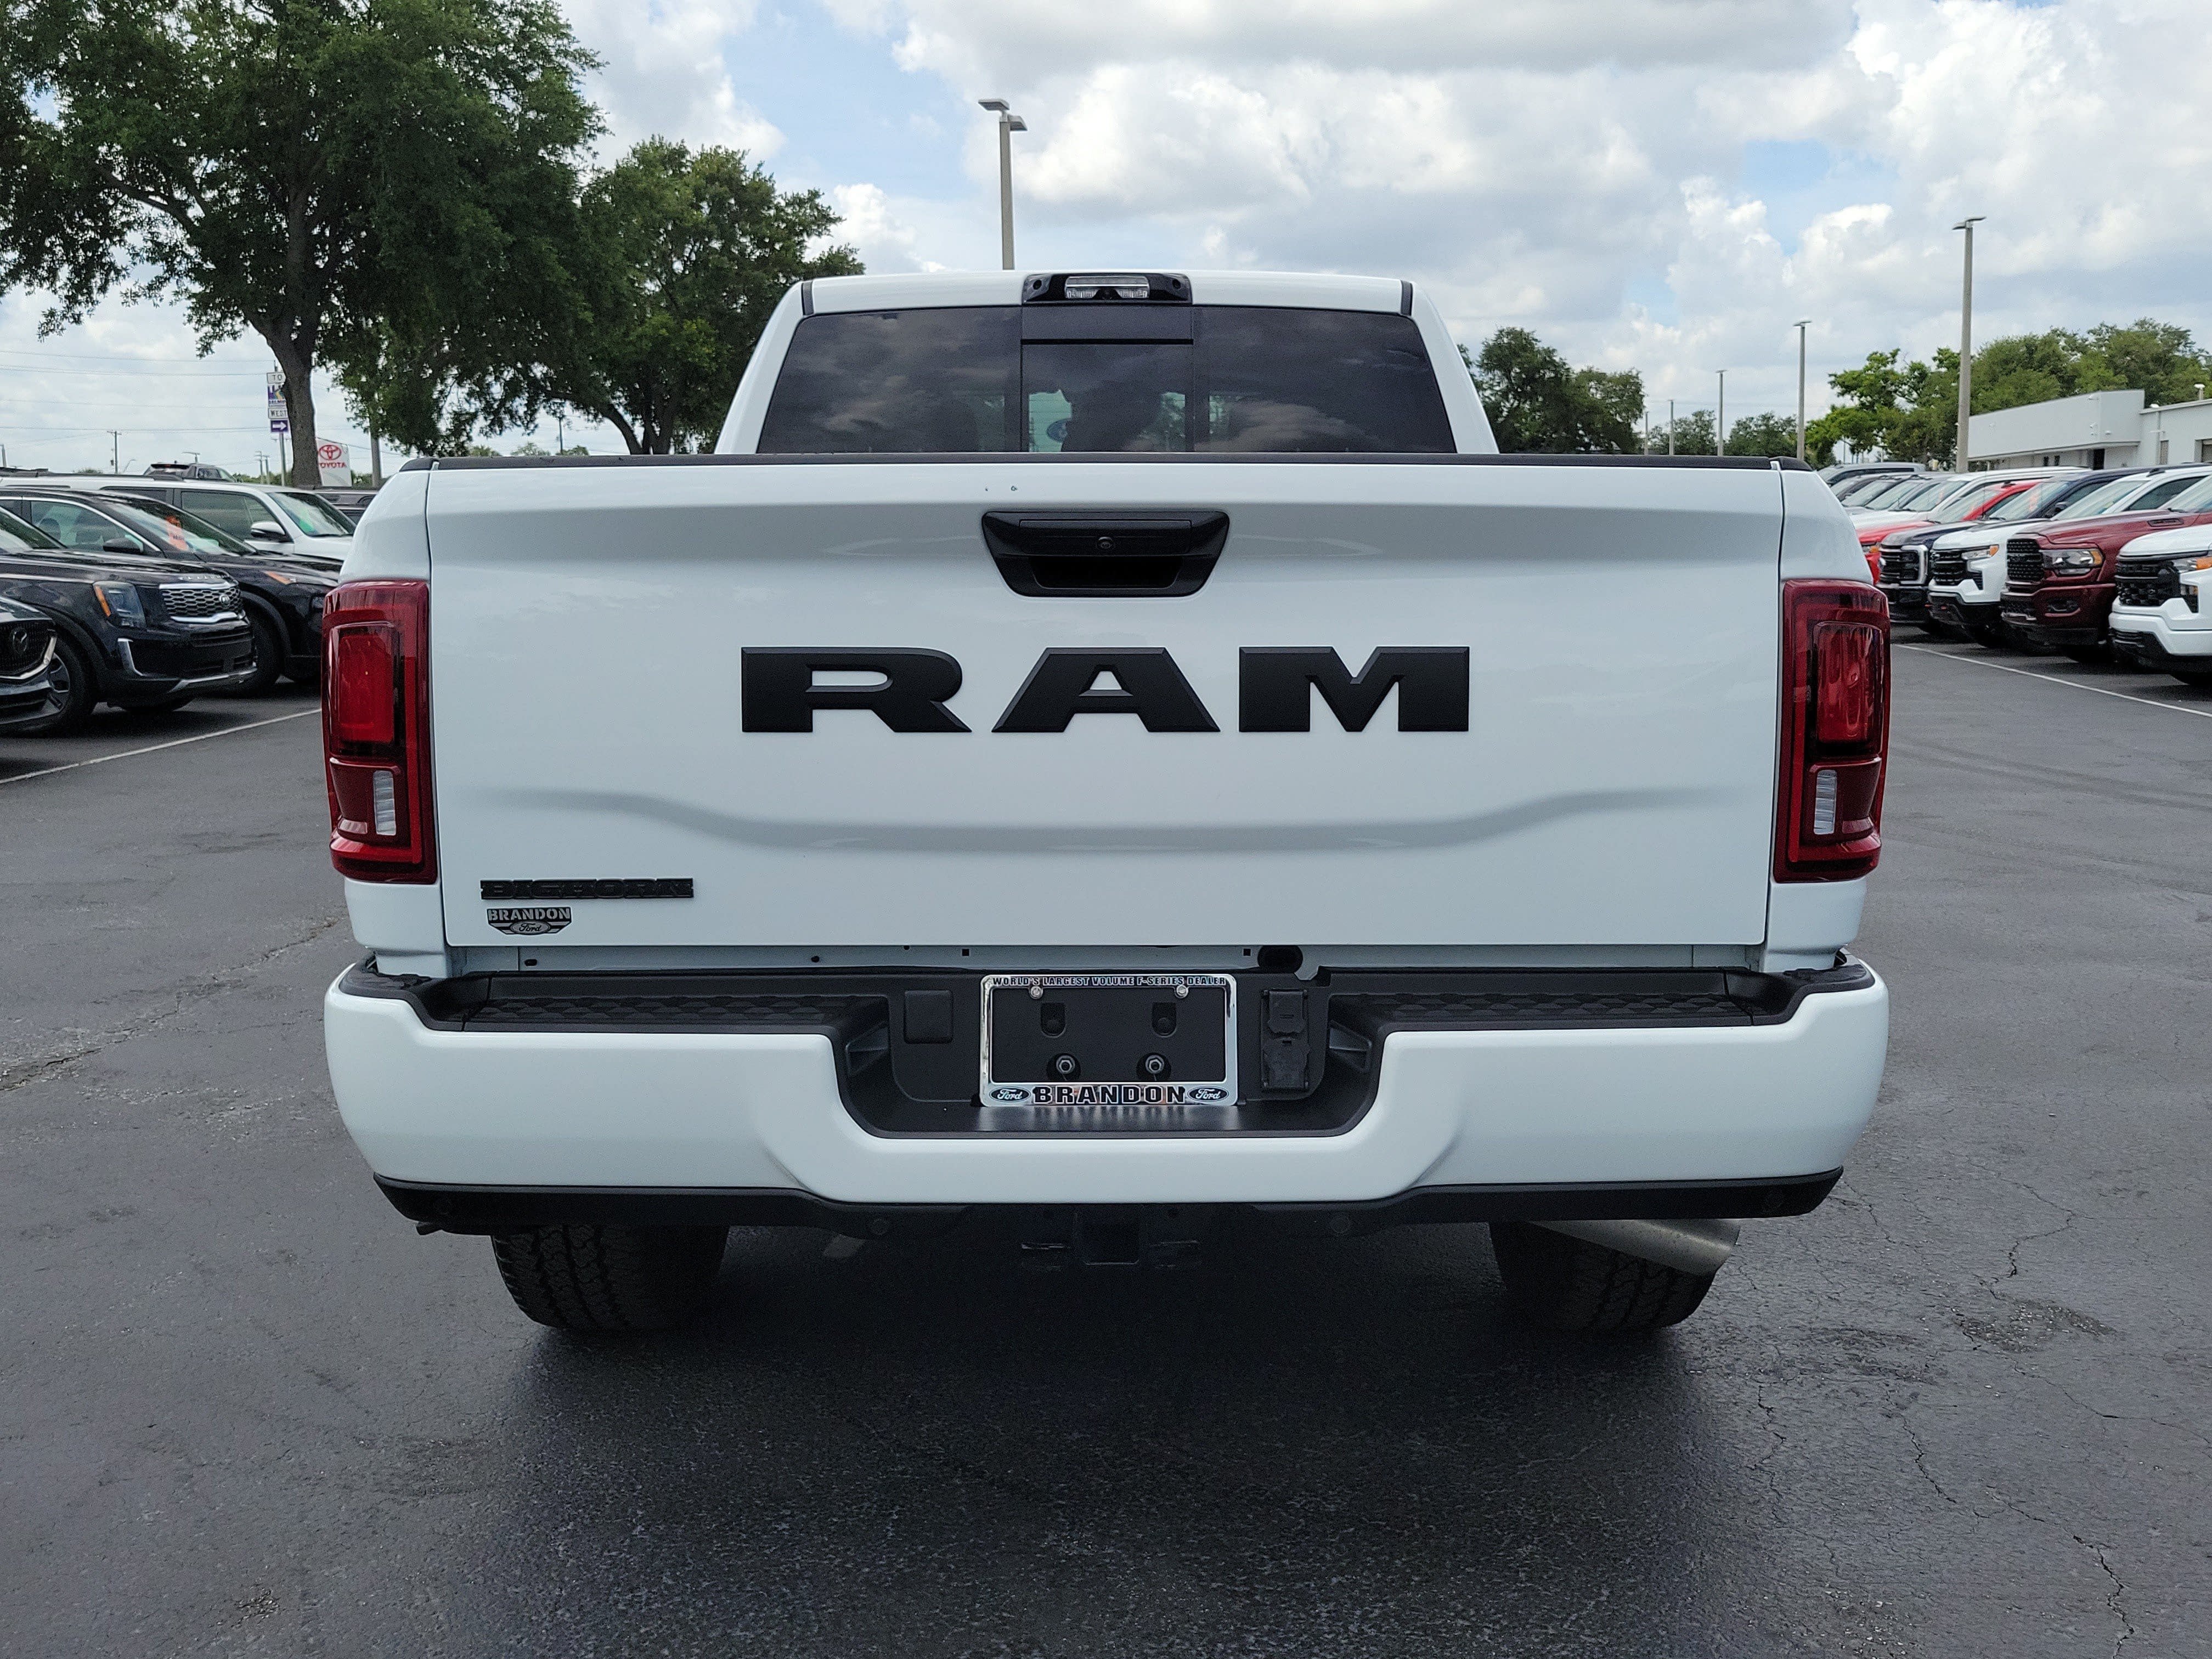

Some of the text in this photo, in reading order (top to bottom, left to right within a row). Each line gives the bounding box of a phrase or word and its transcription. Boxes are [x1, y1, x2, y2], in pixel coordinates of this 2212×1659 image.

[741, 647, 1469, 733] RAM
[488, 908, 569, 921] BRANDON
[518, 923, 542, 933] Ford
[992, 977, 1227, 986] WORLD'S LARGEST VOLUME F-SERIES DEALER
[996, 1090, 1023, 1101] Ford
[1032, 1085, 1186, 1104] BRANDON
[1195, 1090, 1222, 1100] Ford
